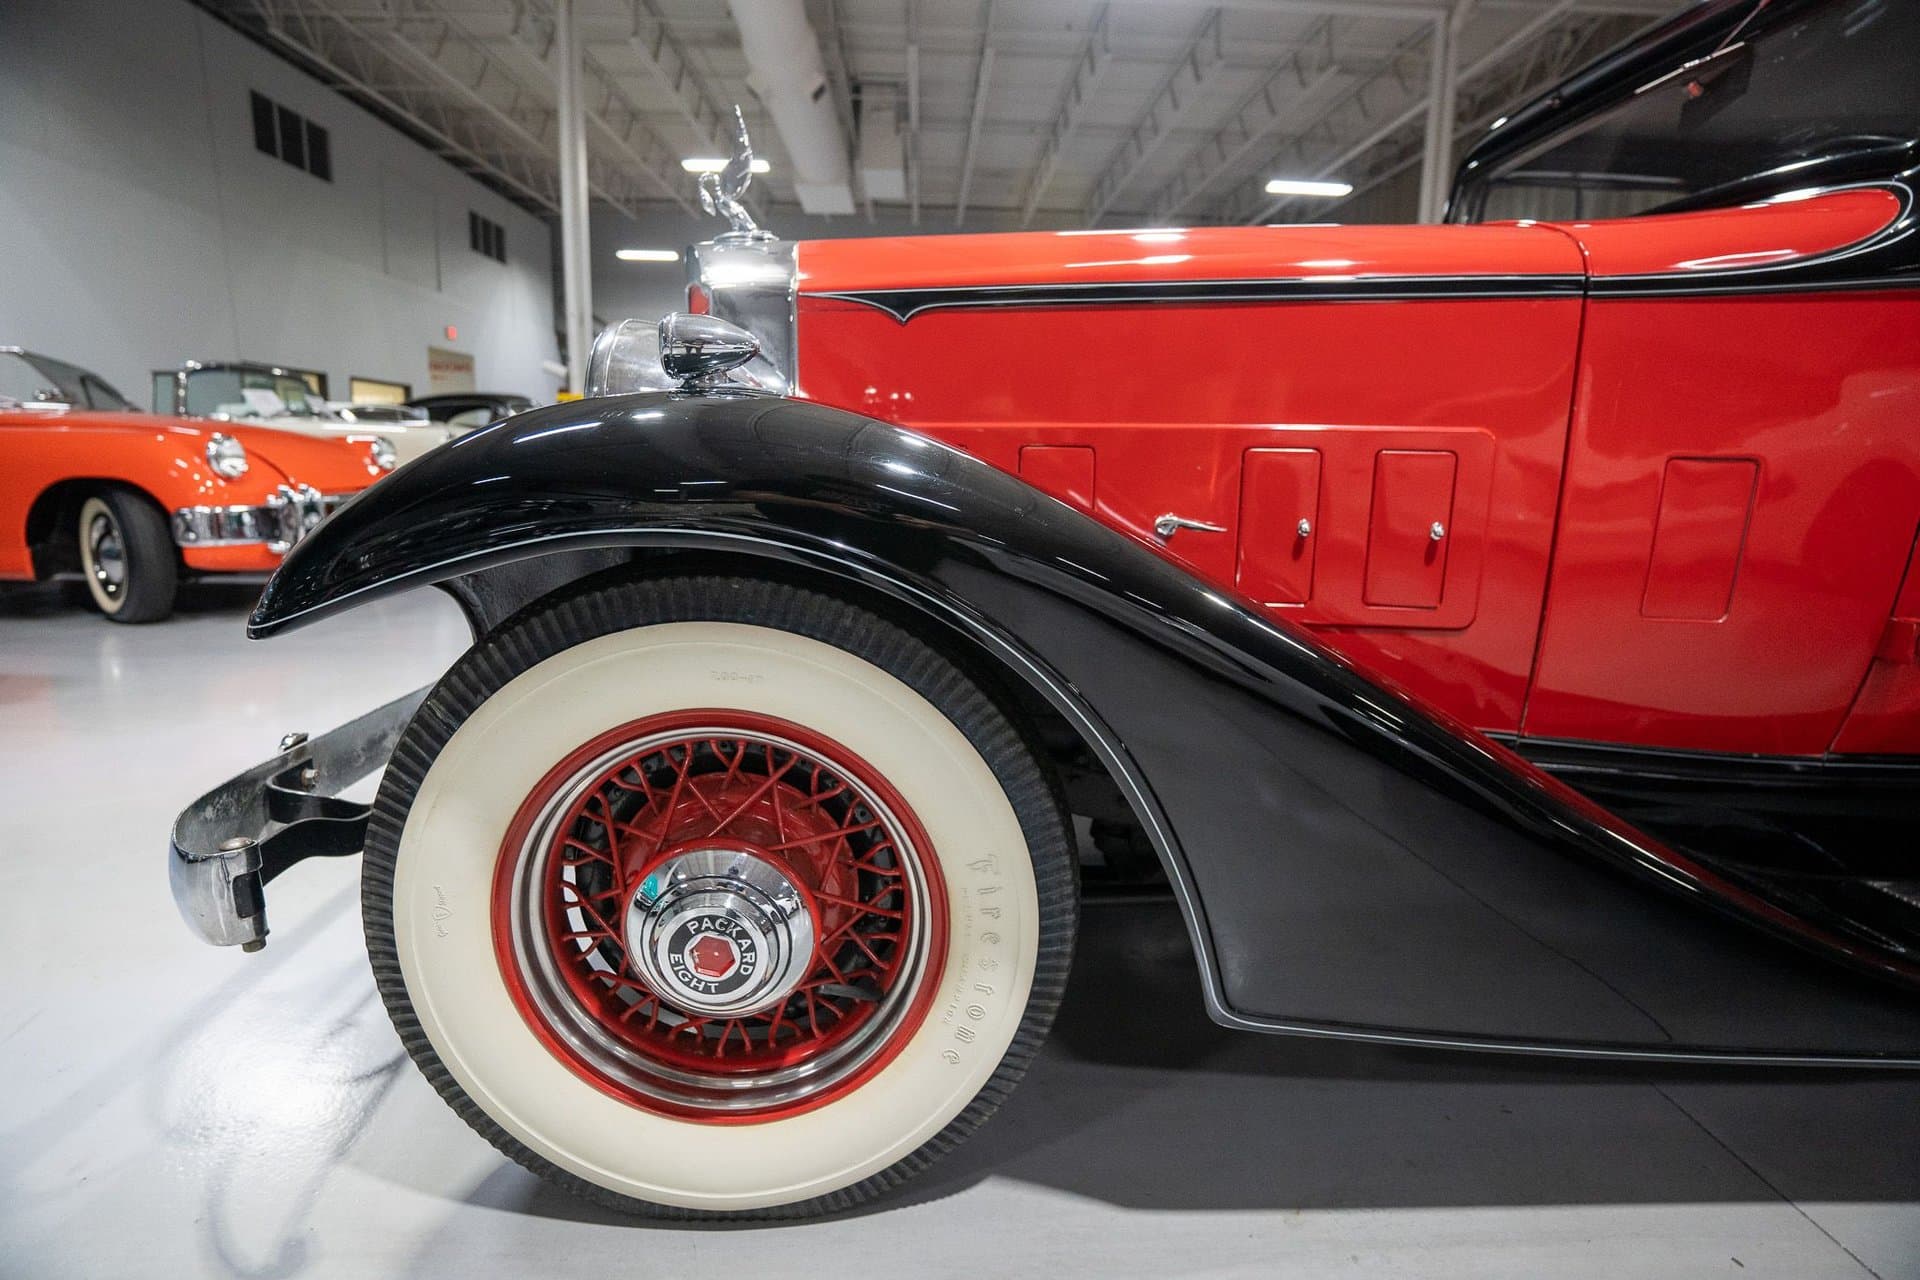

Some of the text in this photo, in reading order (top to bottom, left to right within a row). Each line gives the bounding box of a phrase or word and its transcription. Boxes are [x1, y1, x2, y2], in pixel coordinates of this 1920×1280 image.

[669, 952, 719, 993] EIGHT
[686, 917, 756, 975] PACKARD
[942, 853, 1001, 1064] Firestone
